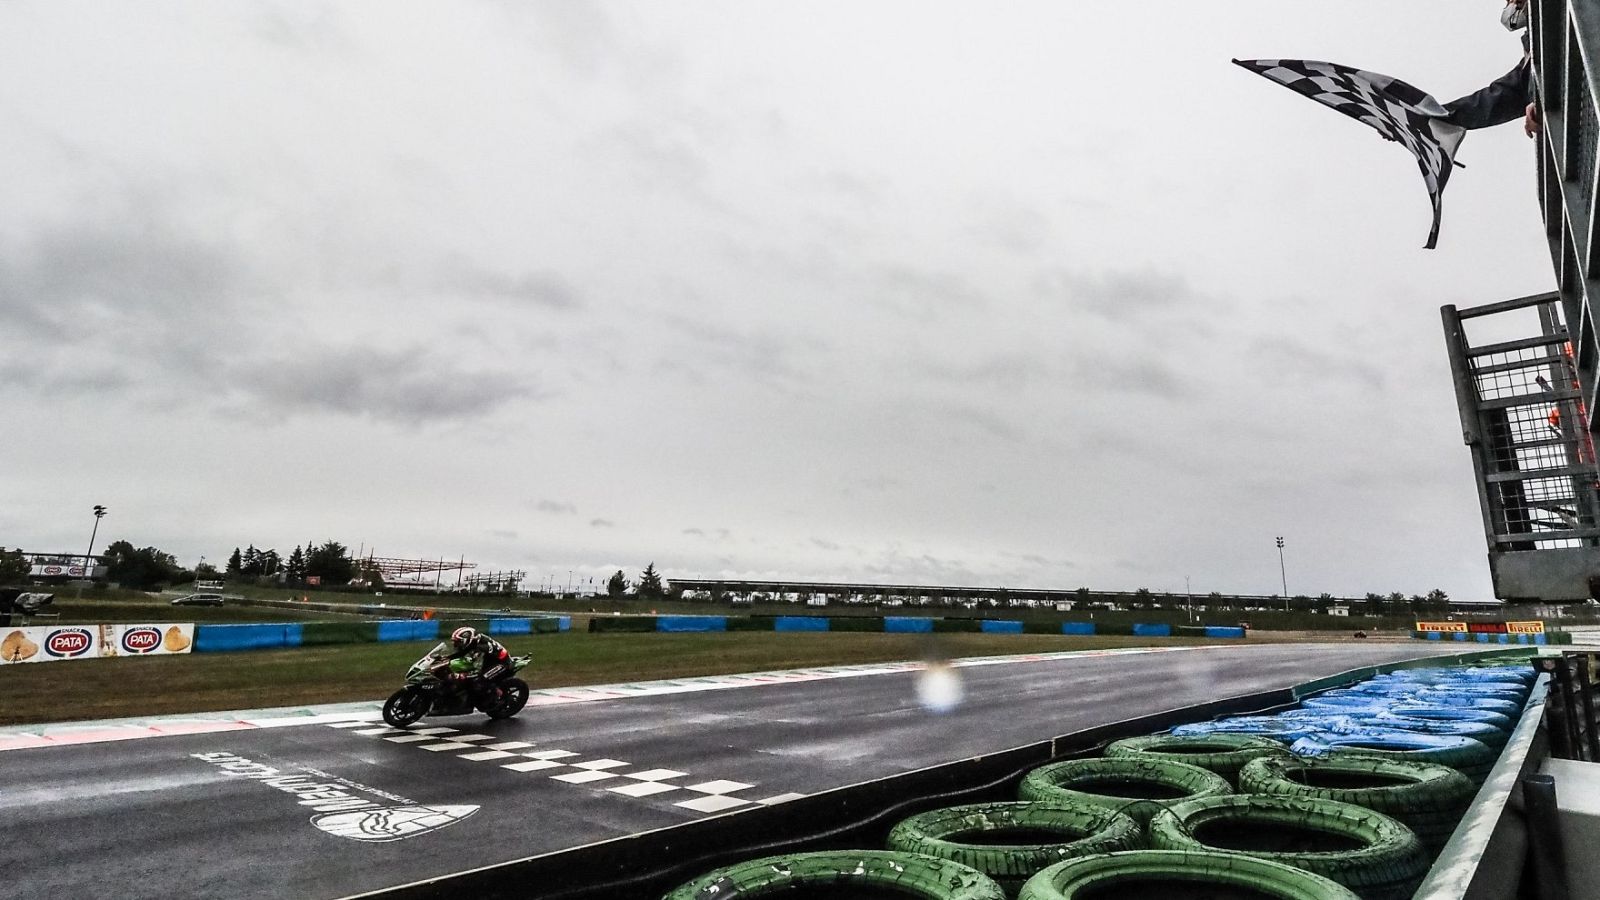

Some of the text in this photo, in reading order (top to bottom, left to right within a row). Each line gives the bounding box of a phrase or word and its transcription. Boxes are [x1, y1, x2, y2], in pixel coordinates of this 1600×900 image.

[1508, 622, 1542, 632] PIRELLI
[55, 636, 82, 649] PATA
[130, 634, 154, 646] PATA
